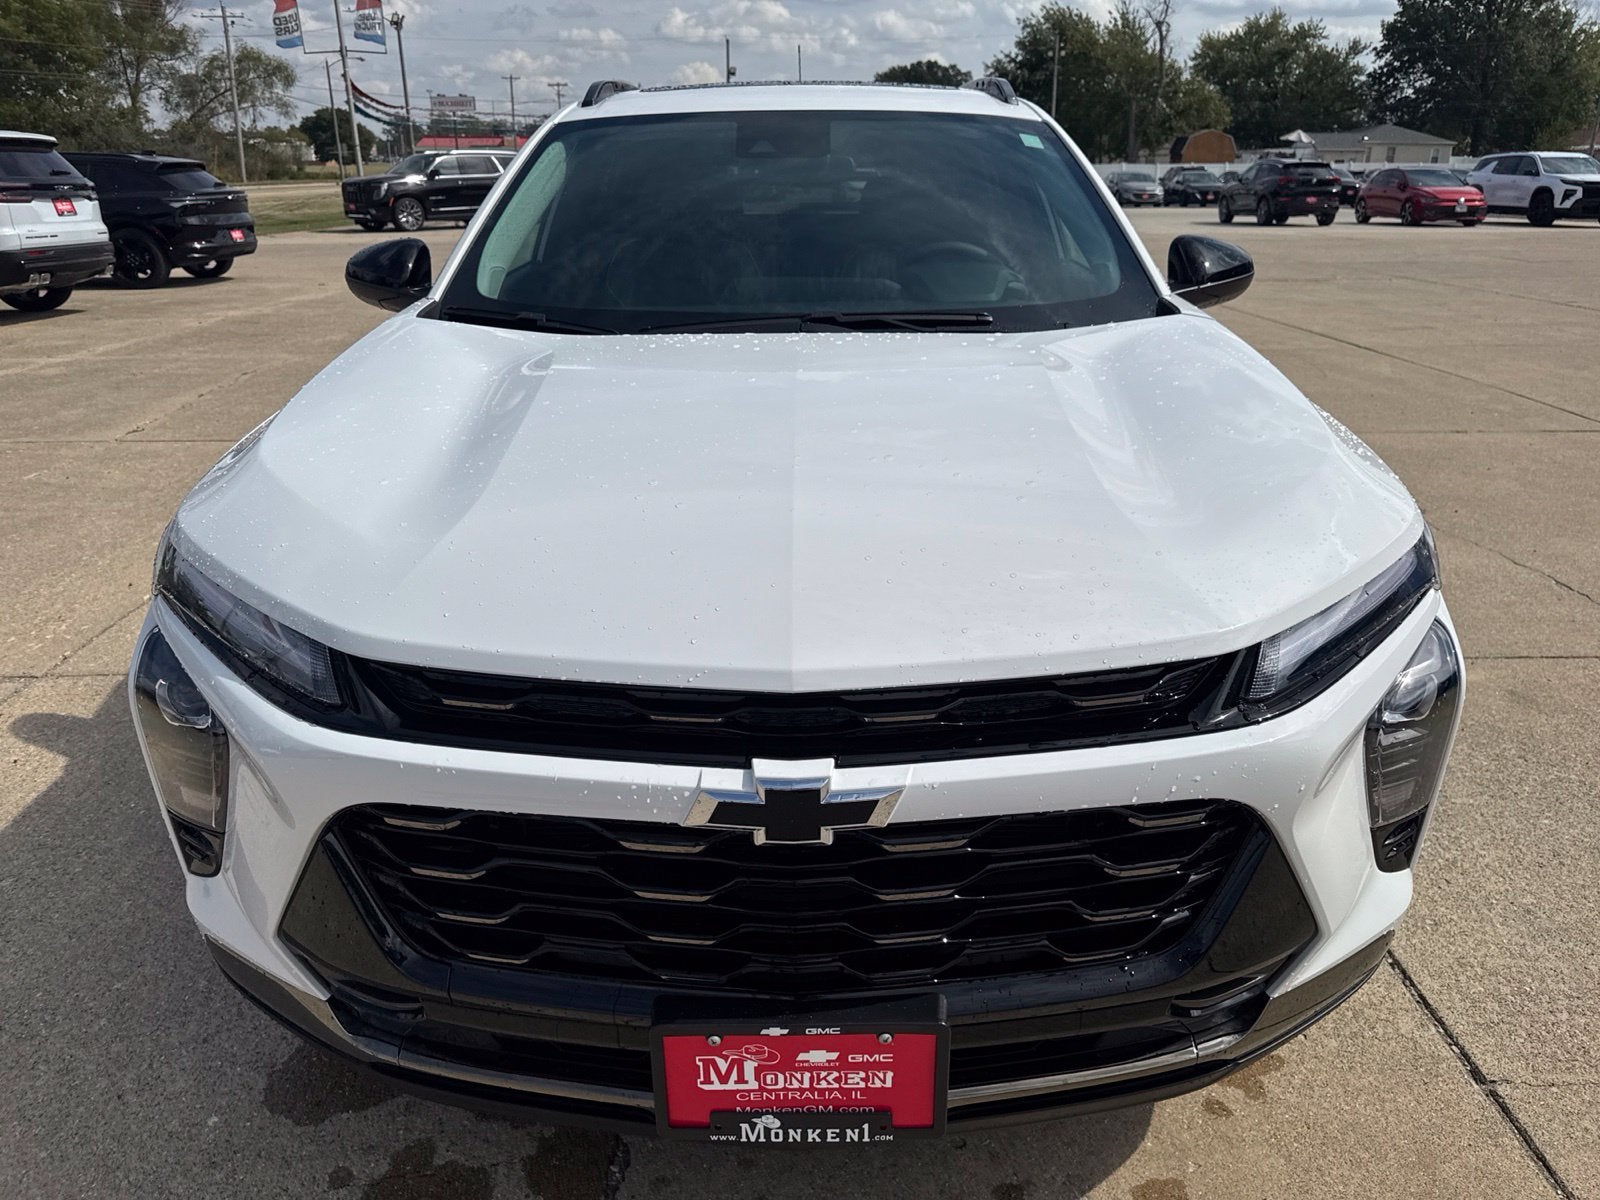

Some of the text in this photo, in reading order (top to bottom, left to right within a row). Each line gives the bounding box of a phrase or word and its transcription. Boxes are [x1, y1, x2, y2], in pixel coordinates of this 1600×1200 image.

[805, 1027, 841, 1035] GMC
[848, 1053, 894, 1063] GMC
[736, 1090, 867, 1101] CENTRALIA, IL
[735, 1105, 875, 1113] MonkenGMcom
